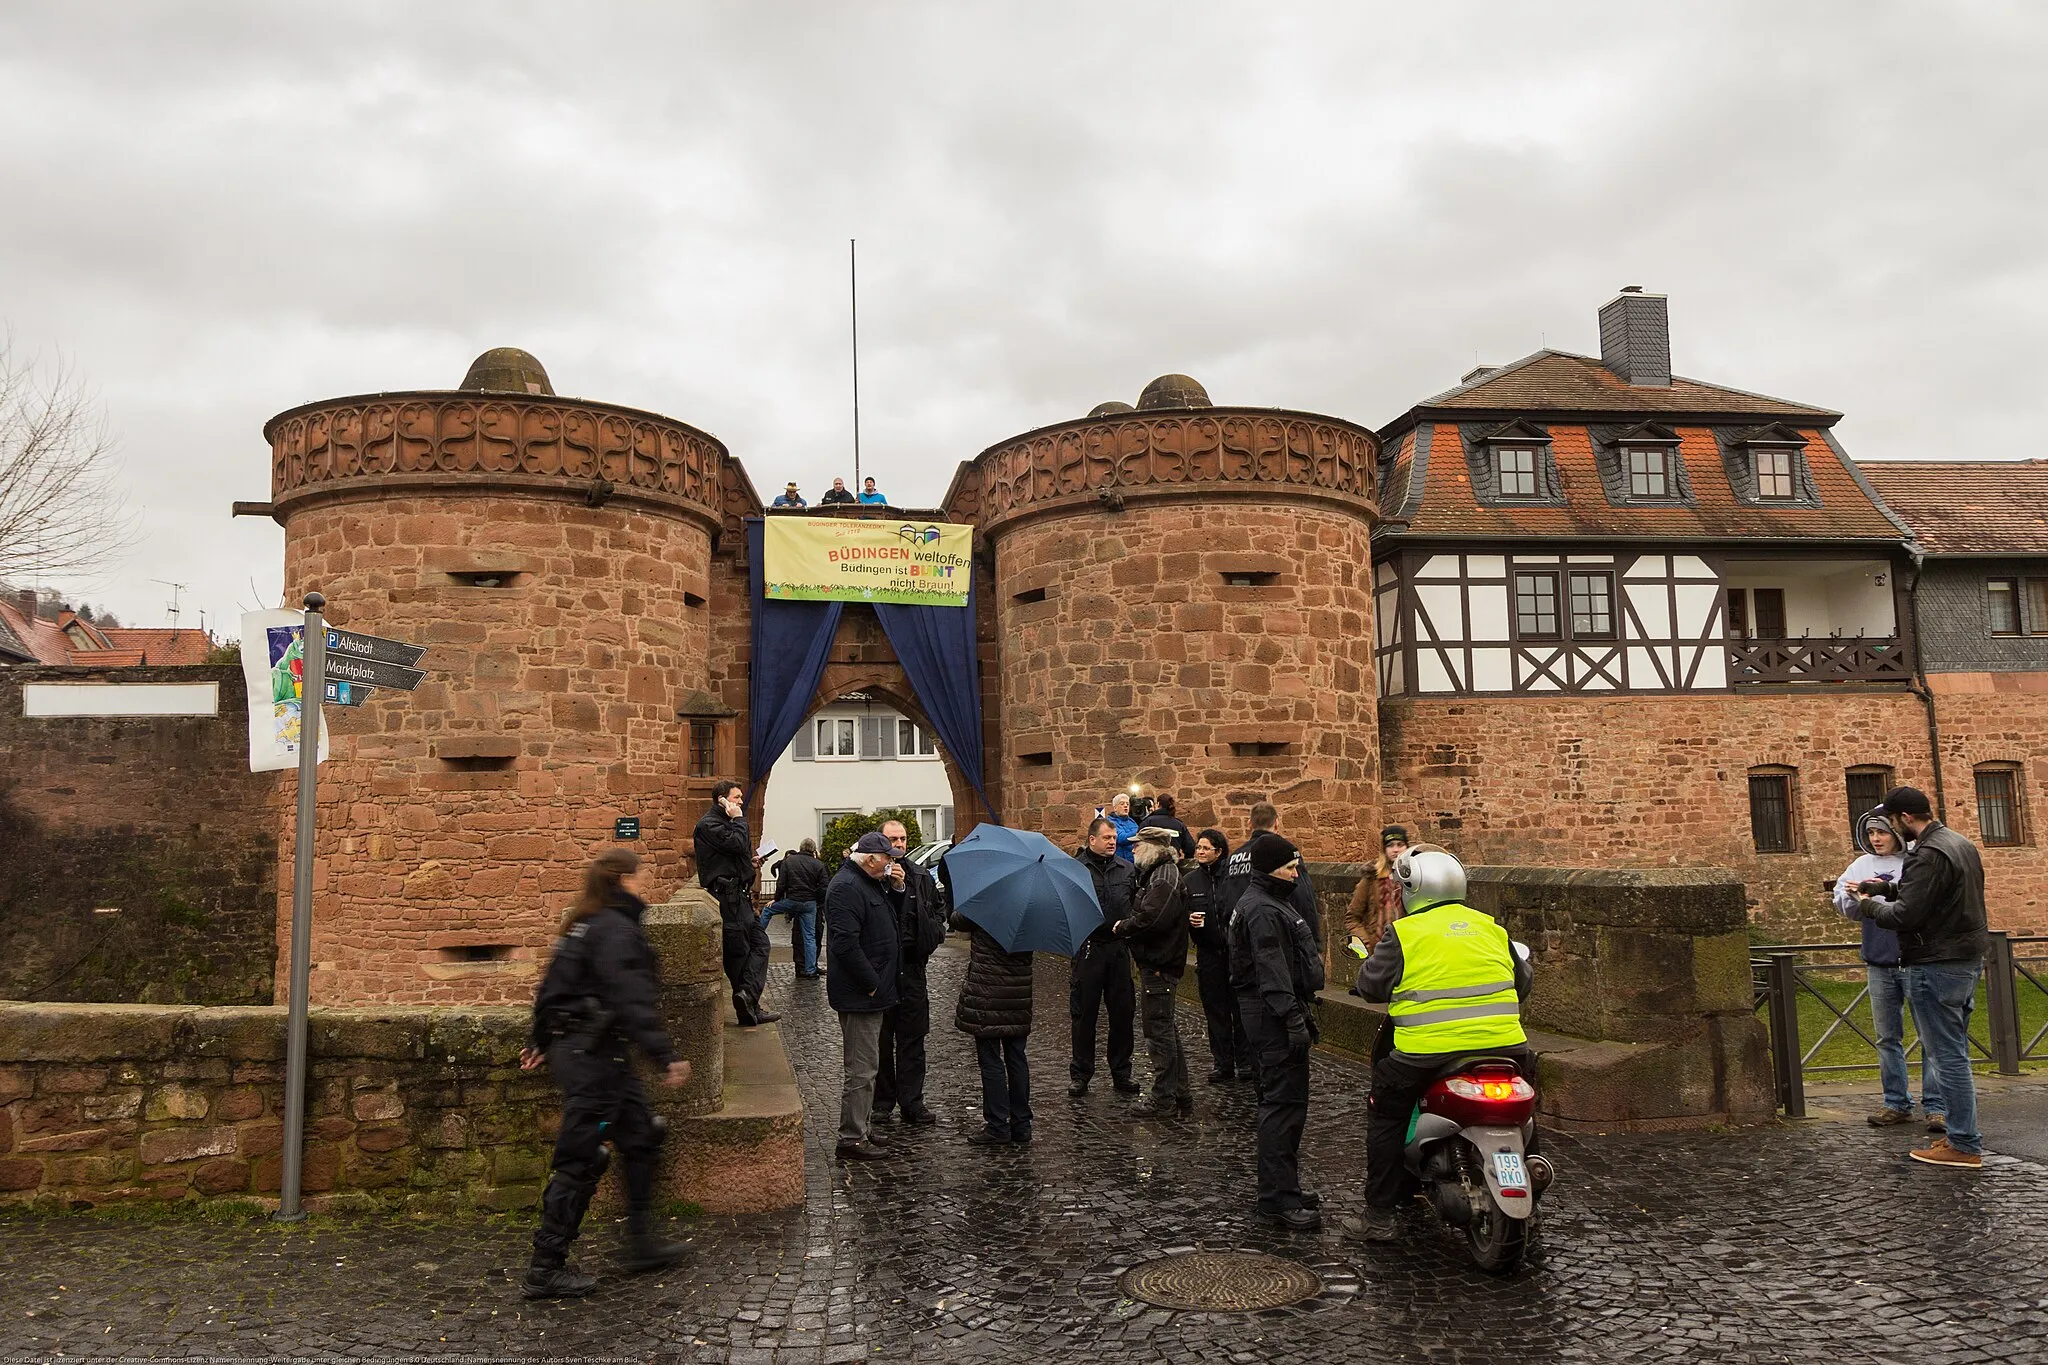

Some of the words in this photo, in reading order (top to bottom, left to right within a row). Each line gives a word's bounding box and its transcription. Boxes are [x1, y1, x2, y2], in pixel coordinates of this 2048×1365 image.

[828, 546, 910, 562] BÜDINGEN
[914, 551, 971, 569] weltoffen
[840, 563, 892, 576] Büdingen
[895, 565, 908, 575] ist
[910, 564, 955, 578] BUNT
[890, 578, 916, 588] nicht
[919, 579, 954, 590] Braun!
[329, 634, 336, 646] P
[339, 636, 373, 654] Altstadt
[326, 659, 375, 680] Marktplatz
[1229, 851, 1251, 865] POLI
[1497, 1155, 1519, 1169] 199
